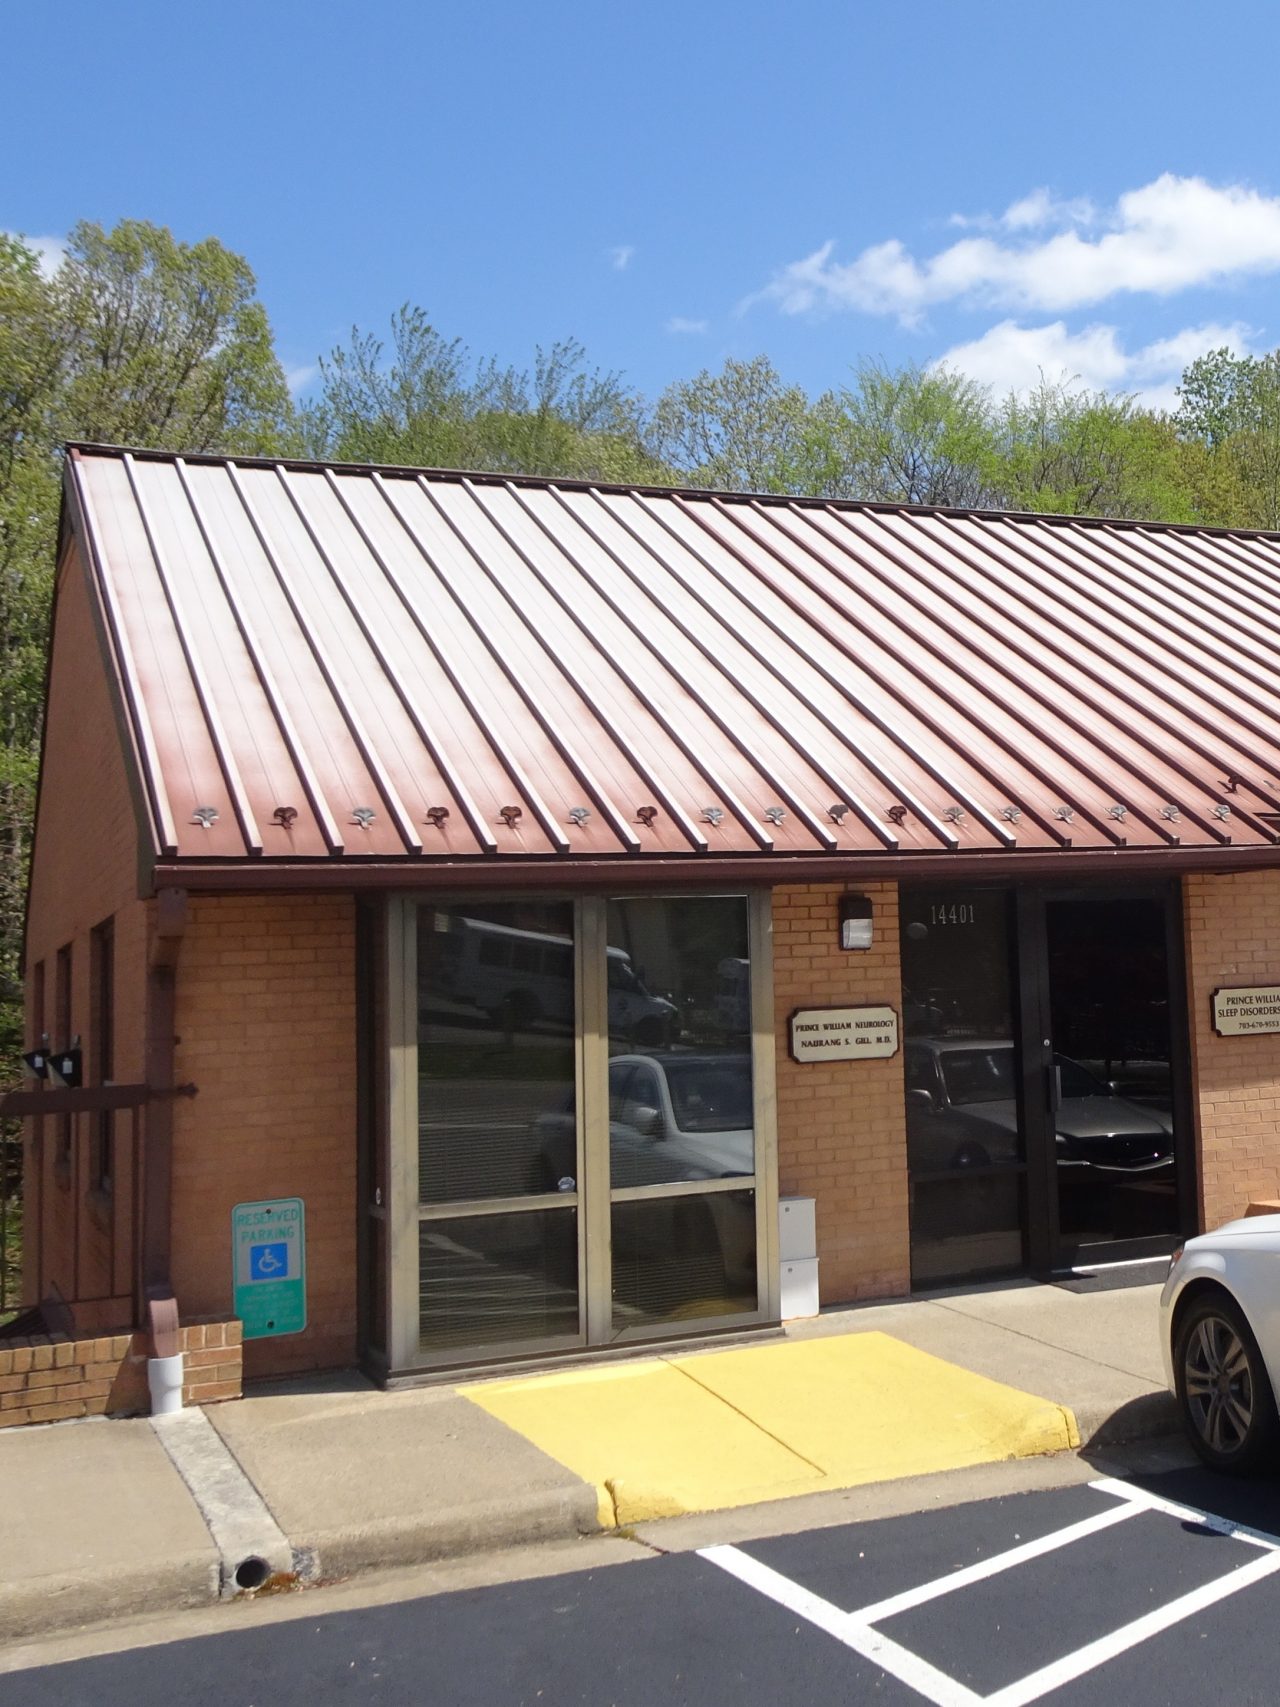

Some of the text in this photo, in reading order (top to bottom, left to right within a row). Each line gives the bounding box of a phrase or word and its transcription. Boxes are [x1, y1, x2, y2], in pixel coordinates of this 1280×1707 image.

[931, 904, 974, 925] 14401
[1226, 995, 1254, 1006] PRINCE
[1217, 1008, 1239, 1018] SLEEP
[1240, 1006, 1280, 1016] DISORDERS
[795, 1020, 894, 1033] PRINCE WILLIAM NEUROLOGY
[801, 1038, 842, 1048] NAURANG
[237, 1208, 299, 1226] RESERVED
[241, 1225, 295, 1244] PARKING
